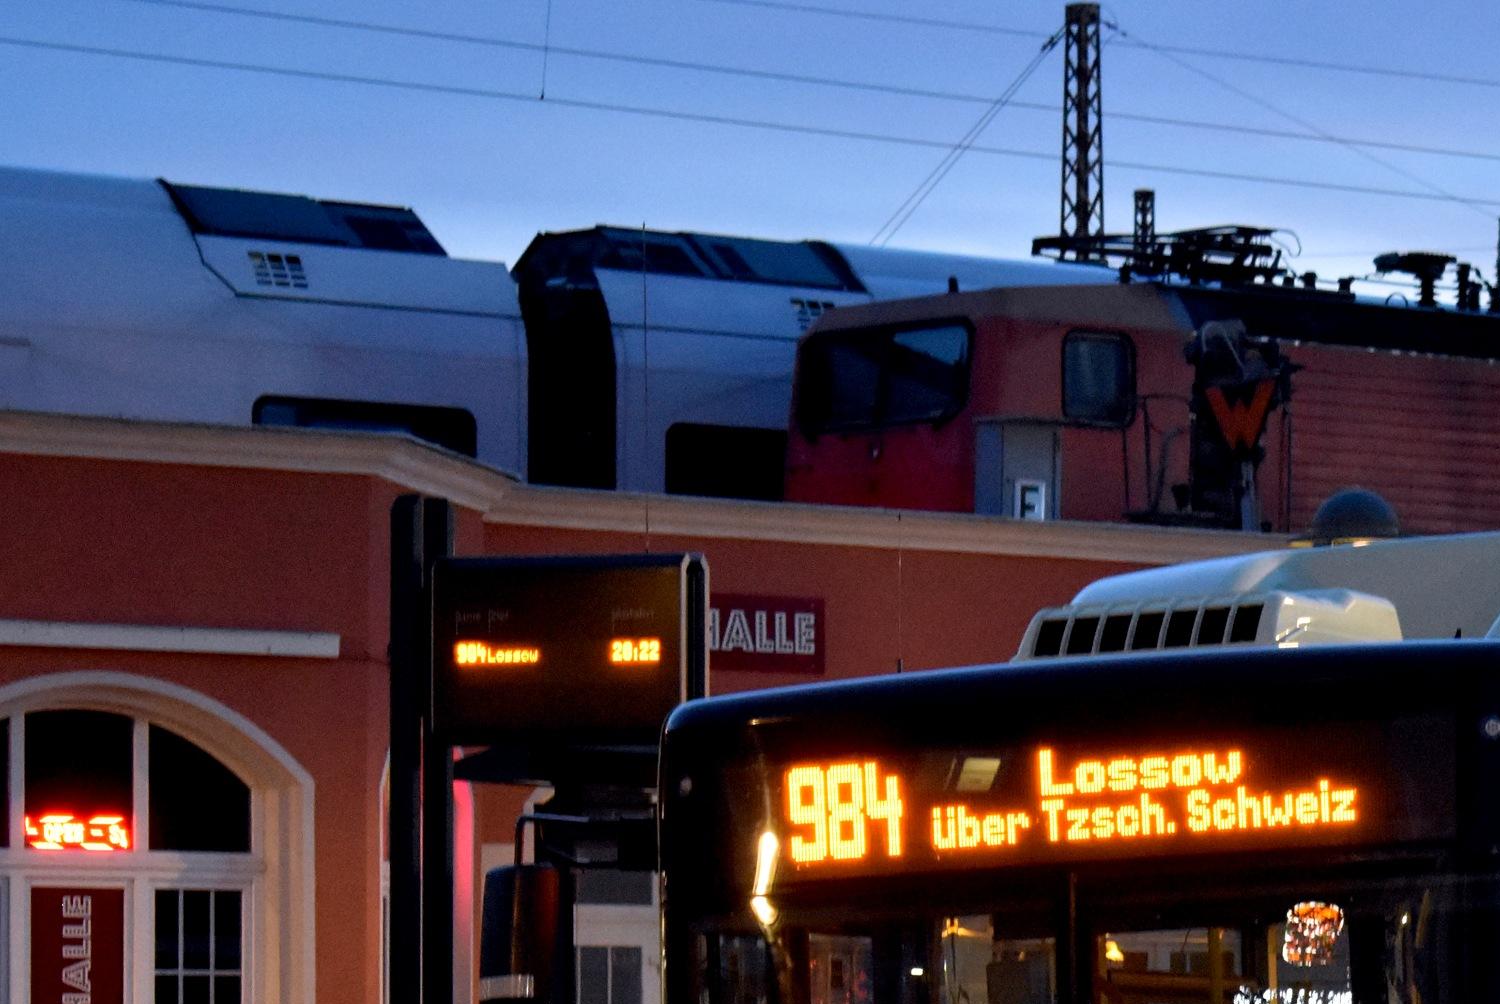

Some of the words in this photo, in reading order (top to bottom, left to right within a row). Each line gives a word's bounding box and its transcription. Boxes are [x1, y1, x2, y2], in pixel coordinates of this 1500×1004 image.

[1038, 749, 1242, 798] Lossow
[788, 762, 904, 863] 984
[931, 805, 1030, 850] über
[1040, 796, 1177, 843] Tzsch.
[1186, 779, 1358, 832] Schweiz
